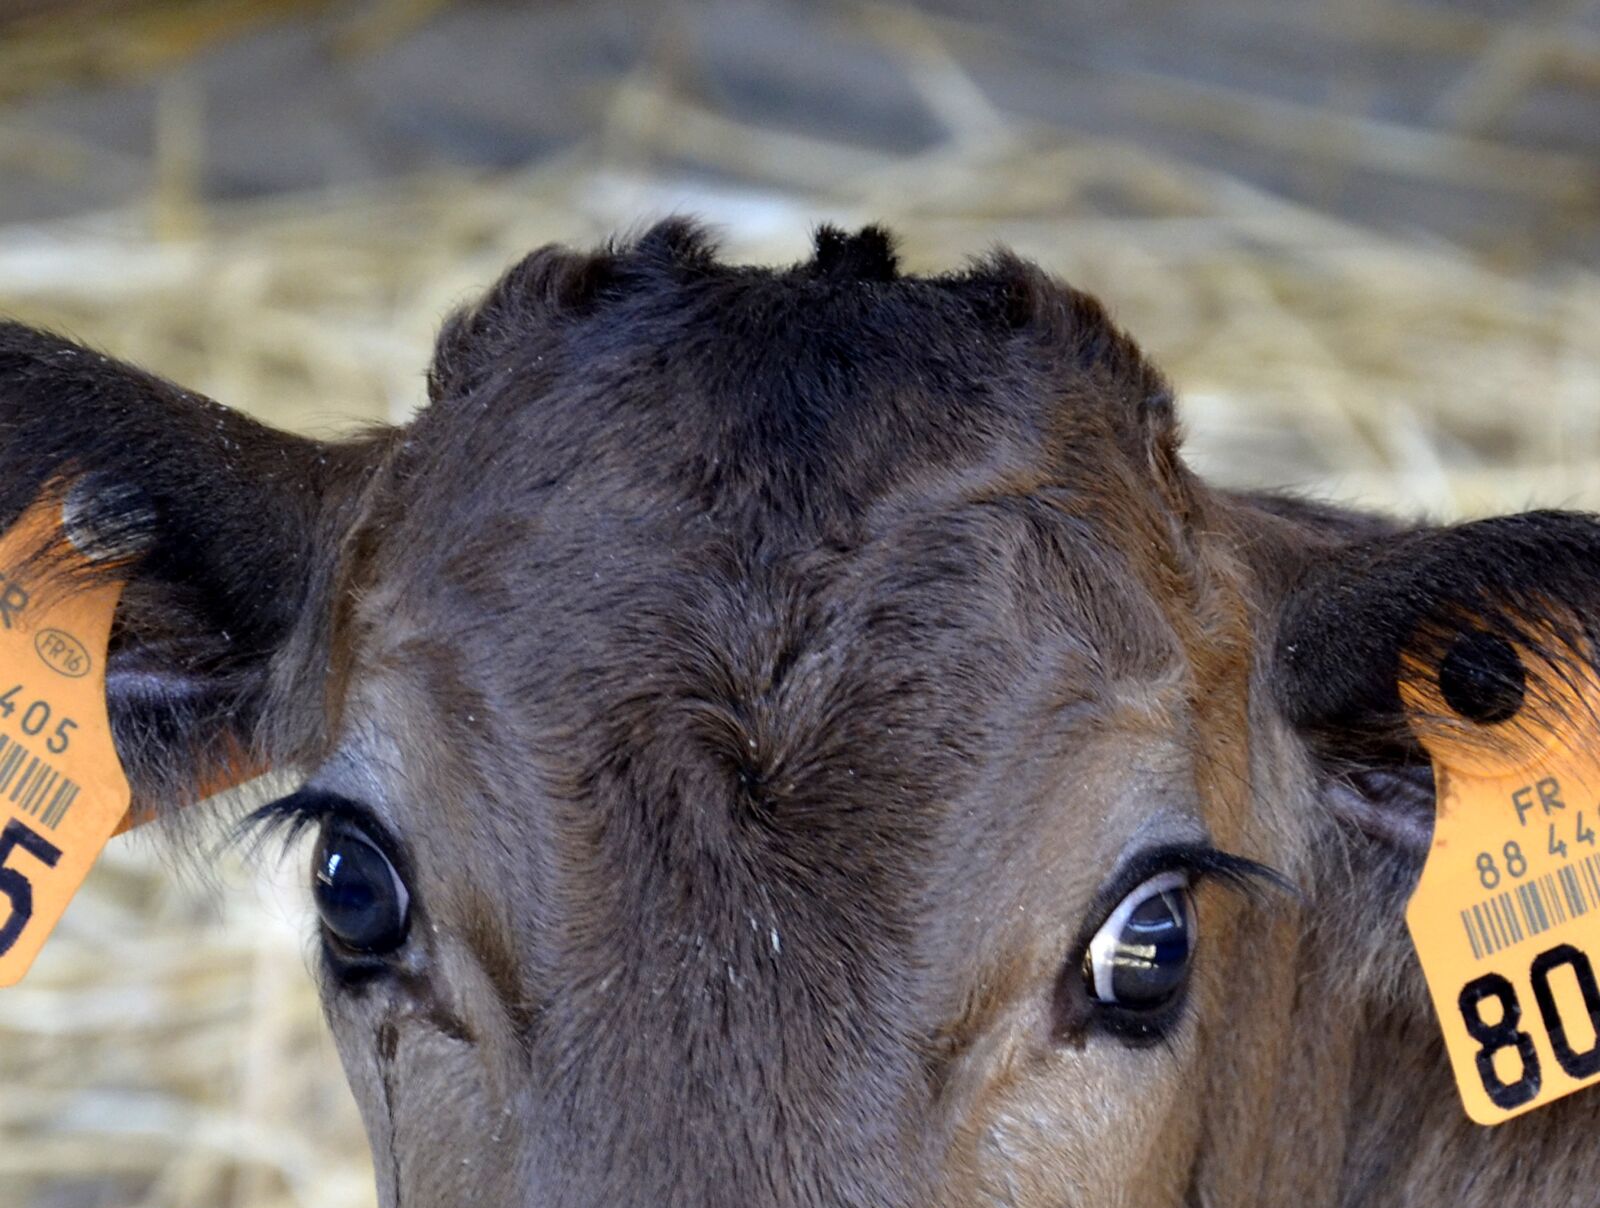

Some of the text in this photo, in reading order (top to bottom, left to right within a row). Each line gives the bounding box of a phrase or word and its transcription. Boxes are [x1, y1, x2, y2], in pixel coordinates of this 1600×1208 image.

[0, 572, 28, 629] R
[0, 685, 78, 754] 405
[1511, 776, 1566, 827] FR
[1476, 802, 1600, 890] 88 44
[0, 817, 63, 957] 5
[1458, 943, 1600, 1111] 80
